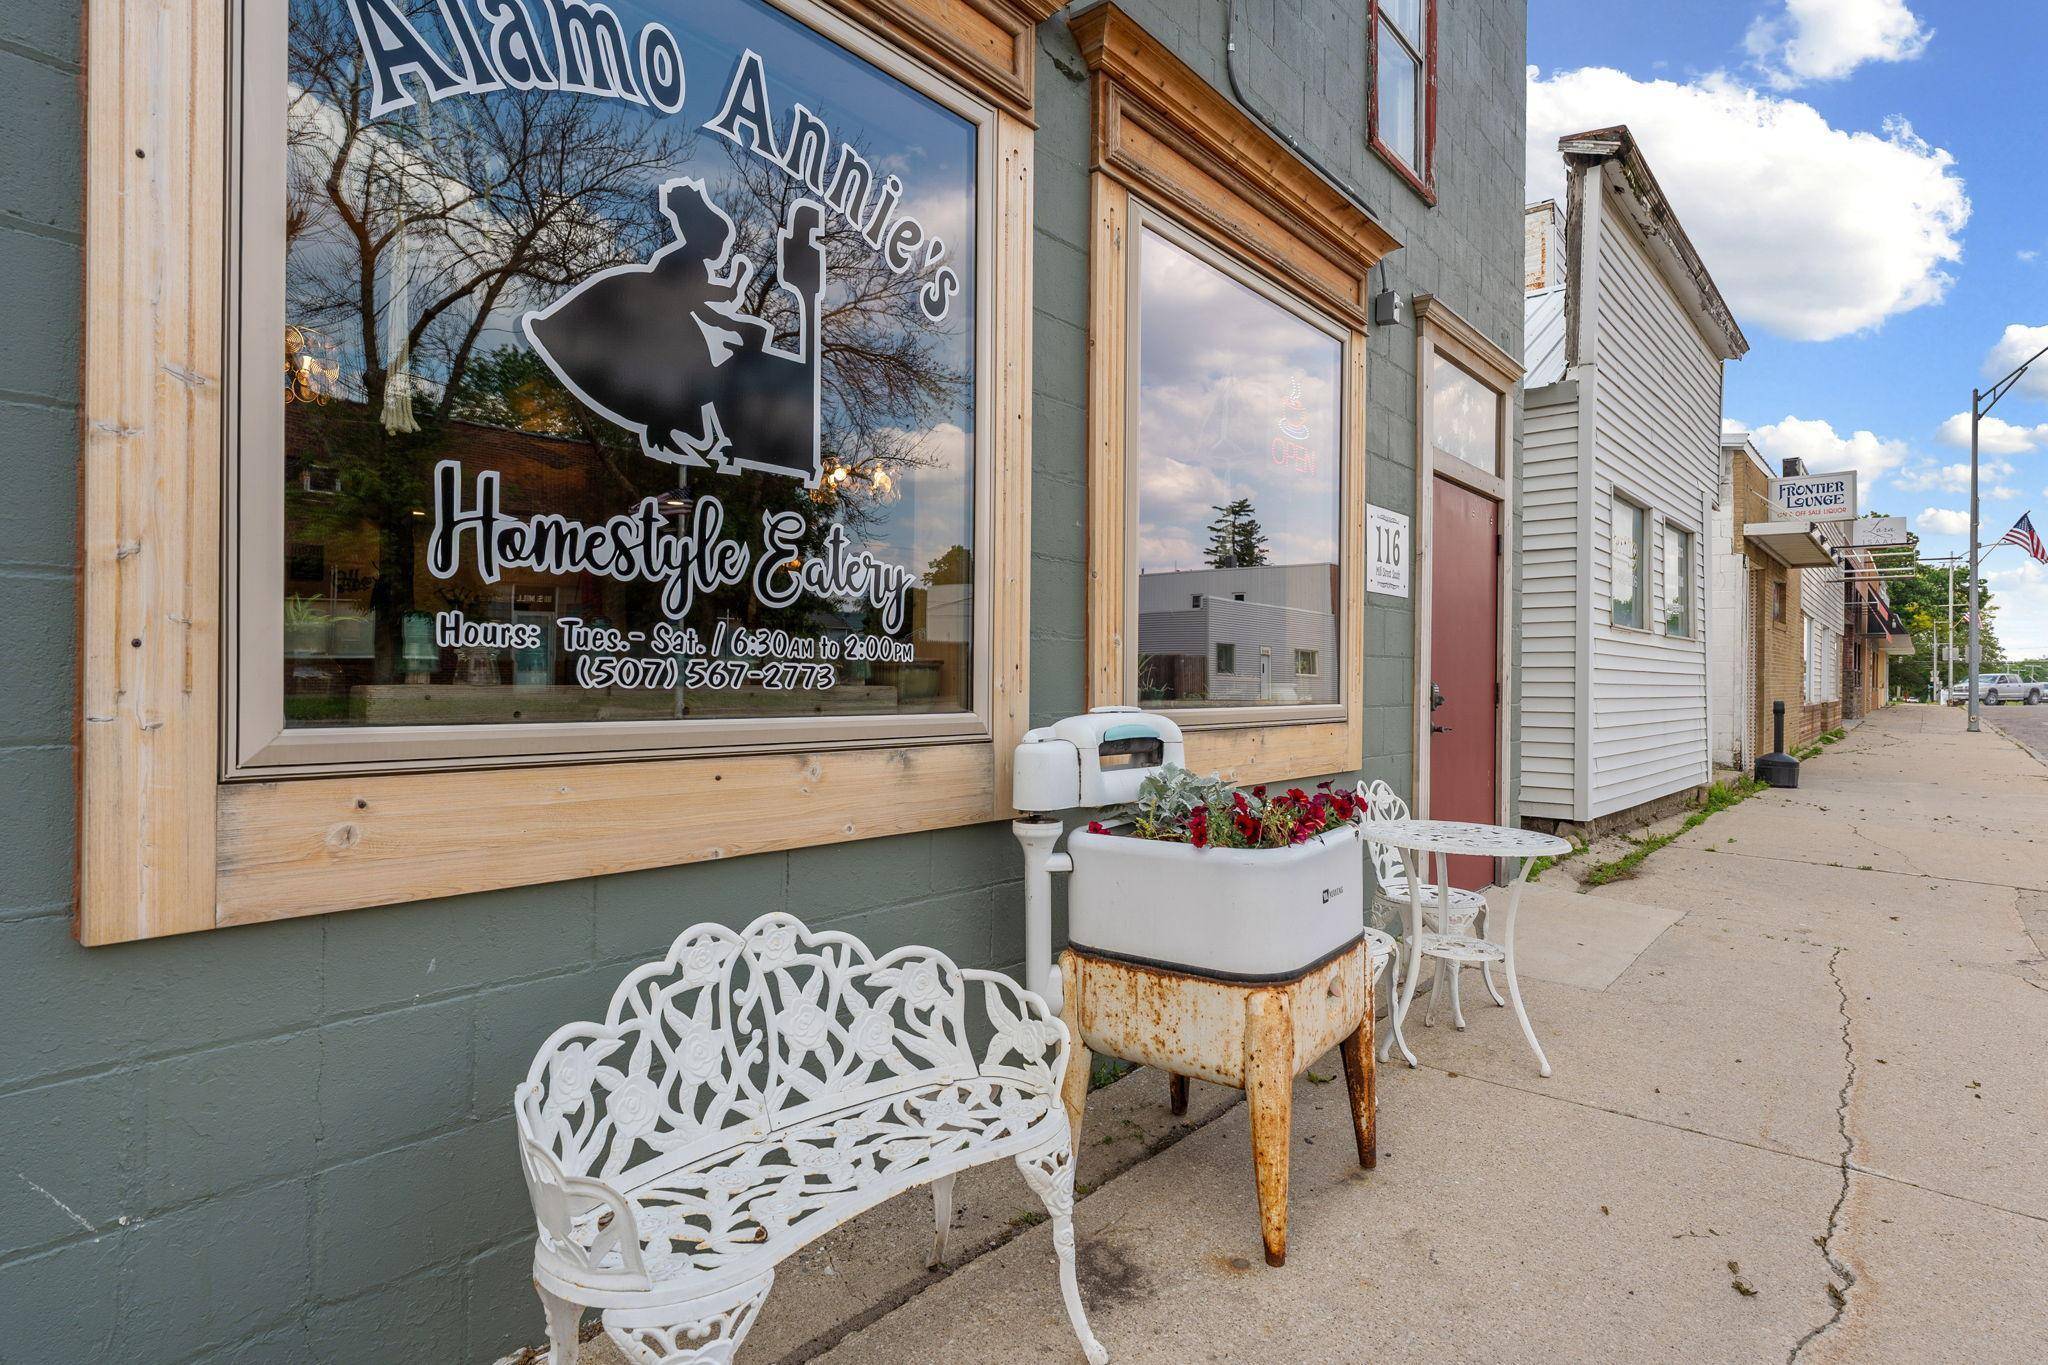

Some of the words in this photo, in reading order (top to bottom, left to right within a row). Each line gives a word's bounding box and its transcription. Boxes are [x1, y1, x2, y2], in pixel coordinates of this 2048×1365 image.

[349, 0, 686, 119] Alamo
[702, 47, 959, 322] Annie's
[1787, 493, 1845, 509] LOUNGE
[1823, 506, 1847, 515] LIQUOR
[427, 460, 750, 620] Homestyle
[753, 509, 918, 635] Eatery
[1376, 525, 1400, 566] 116
[435, 610, 541, 649] Hours:
[651, 622, 706, 655] Sat.
[730, 626, 814, 660] 6:30AM
[819, 635, 839, 661] to
[843, 634, 914, 663] 2:00PM
[576, 656, 679, 690] (507)
[684, 659, 836, 690] 567-2773
